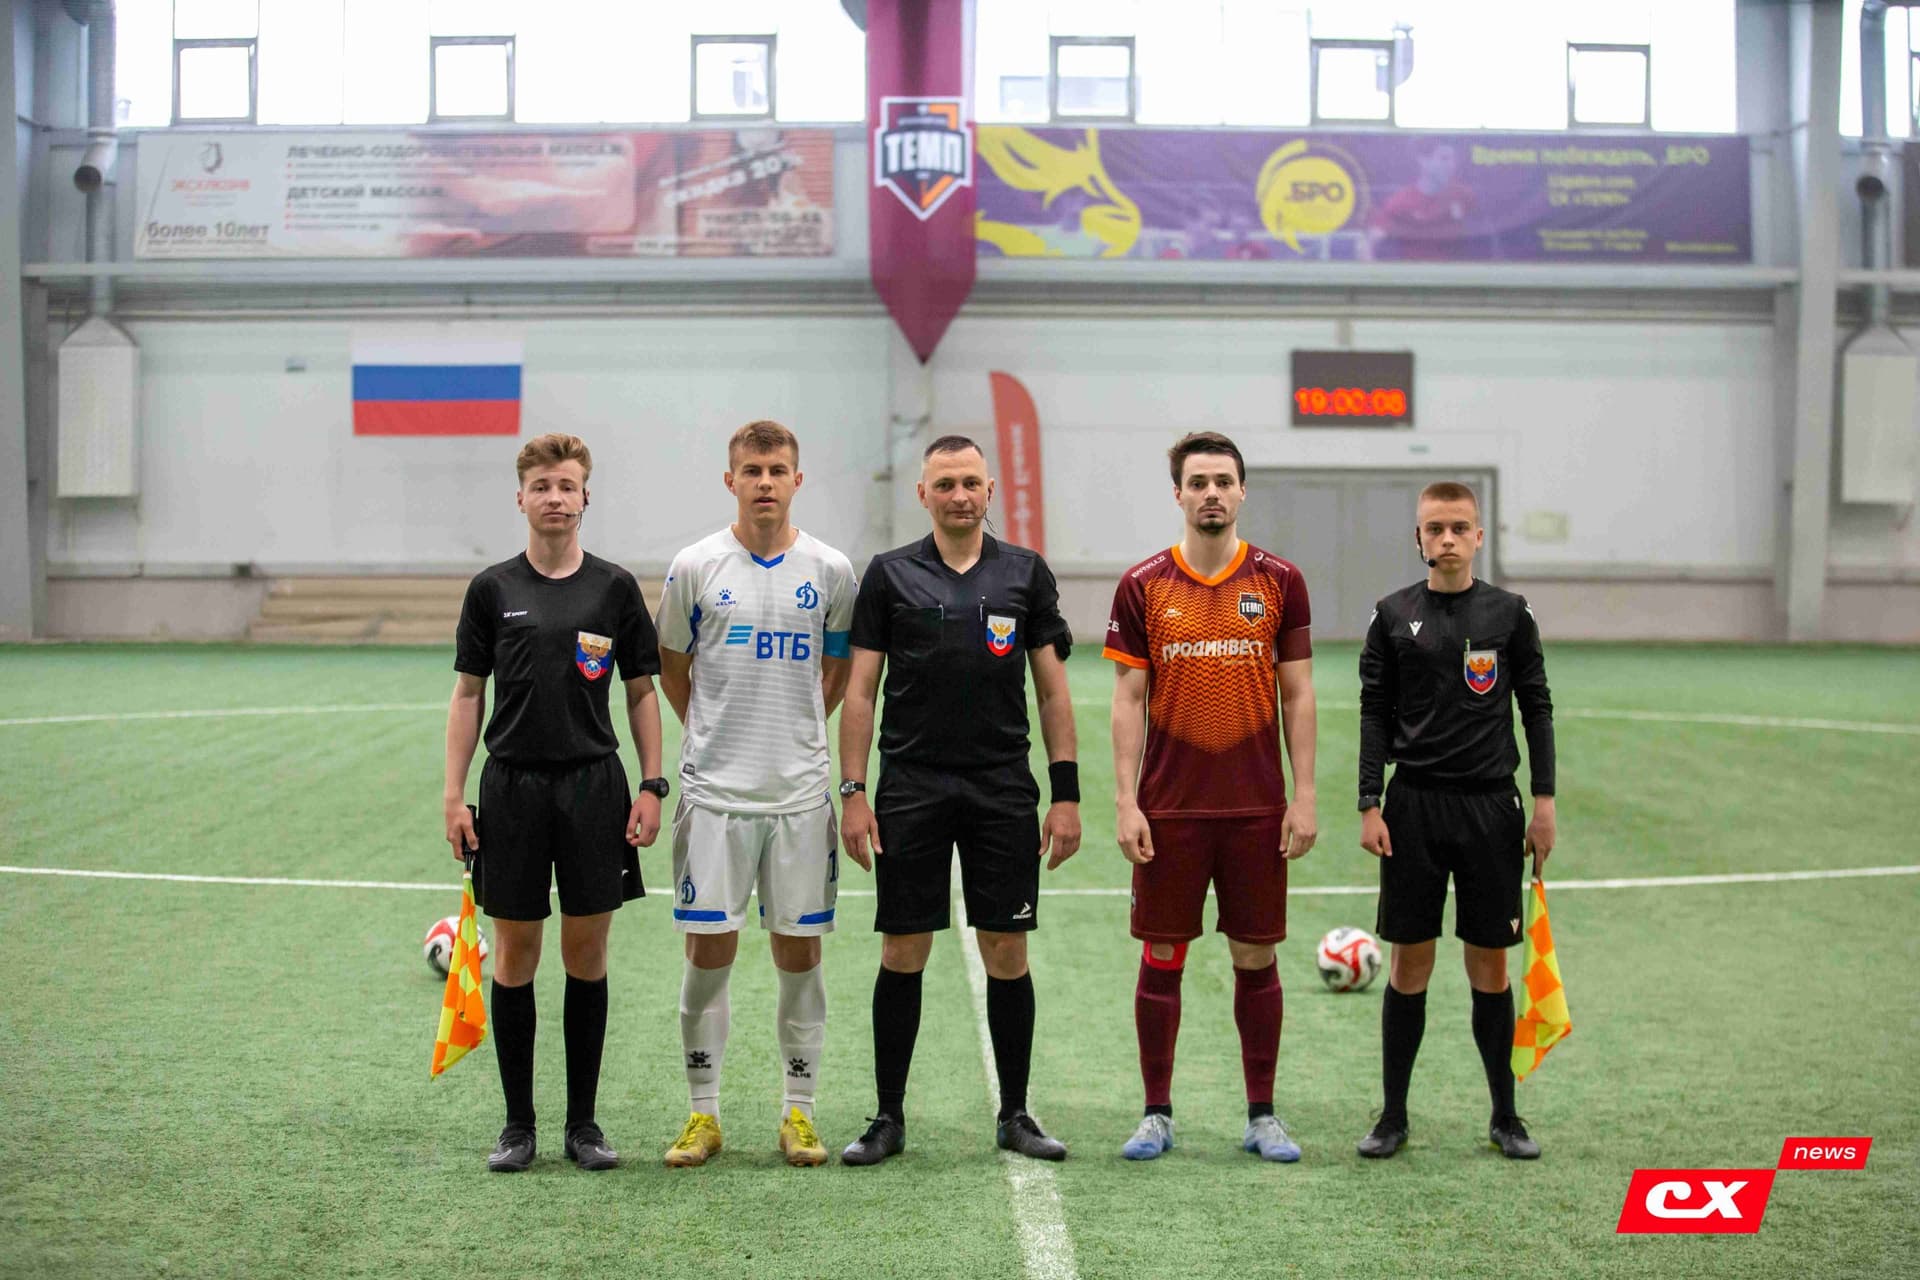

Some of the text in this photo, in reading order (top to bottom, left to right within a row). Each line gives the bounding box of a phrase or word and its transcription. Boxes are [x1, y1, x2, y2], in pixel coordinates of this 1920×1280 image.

[884, 130, 962, 174] ТЕМП
[147, 220, 208, 239] более
[1240, 602, 1263, 614] ТЕМП
[756, 631, 811, 660] ВТБ
[1162, 639, 1264, 663] ПРОДИНВЕСТ
